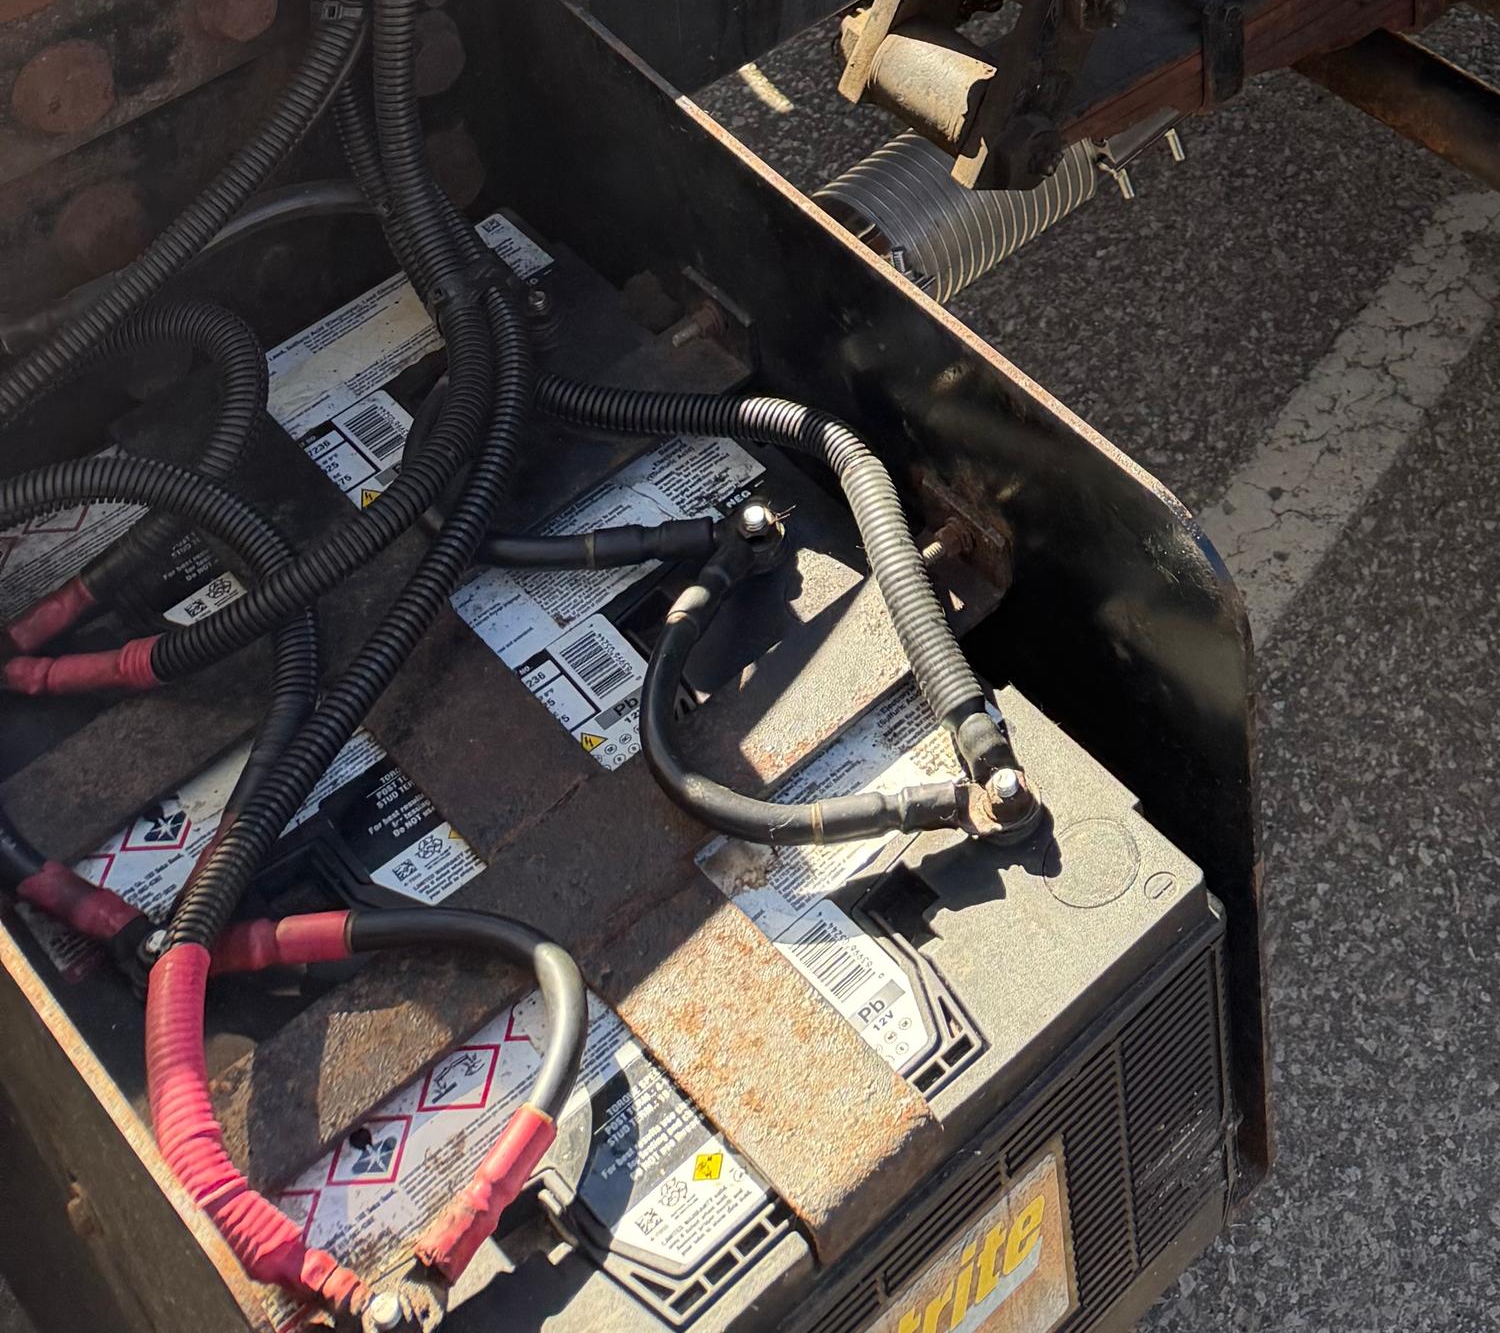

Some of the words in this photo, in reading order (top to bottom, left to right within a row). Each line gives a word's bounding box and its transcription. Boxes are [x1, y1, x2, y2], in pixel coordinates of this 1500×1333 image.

[613, 697, 639, 716] Pb
[857, 995, 887, 1024] Pb
[872, 1010, 896, 1033] 12V
[605, 1085, 641, 1116] TORQUE
[603, 1112, 628, 1135] POST
[605, 1123, 632, 1147] STUD
